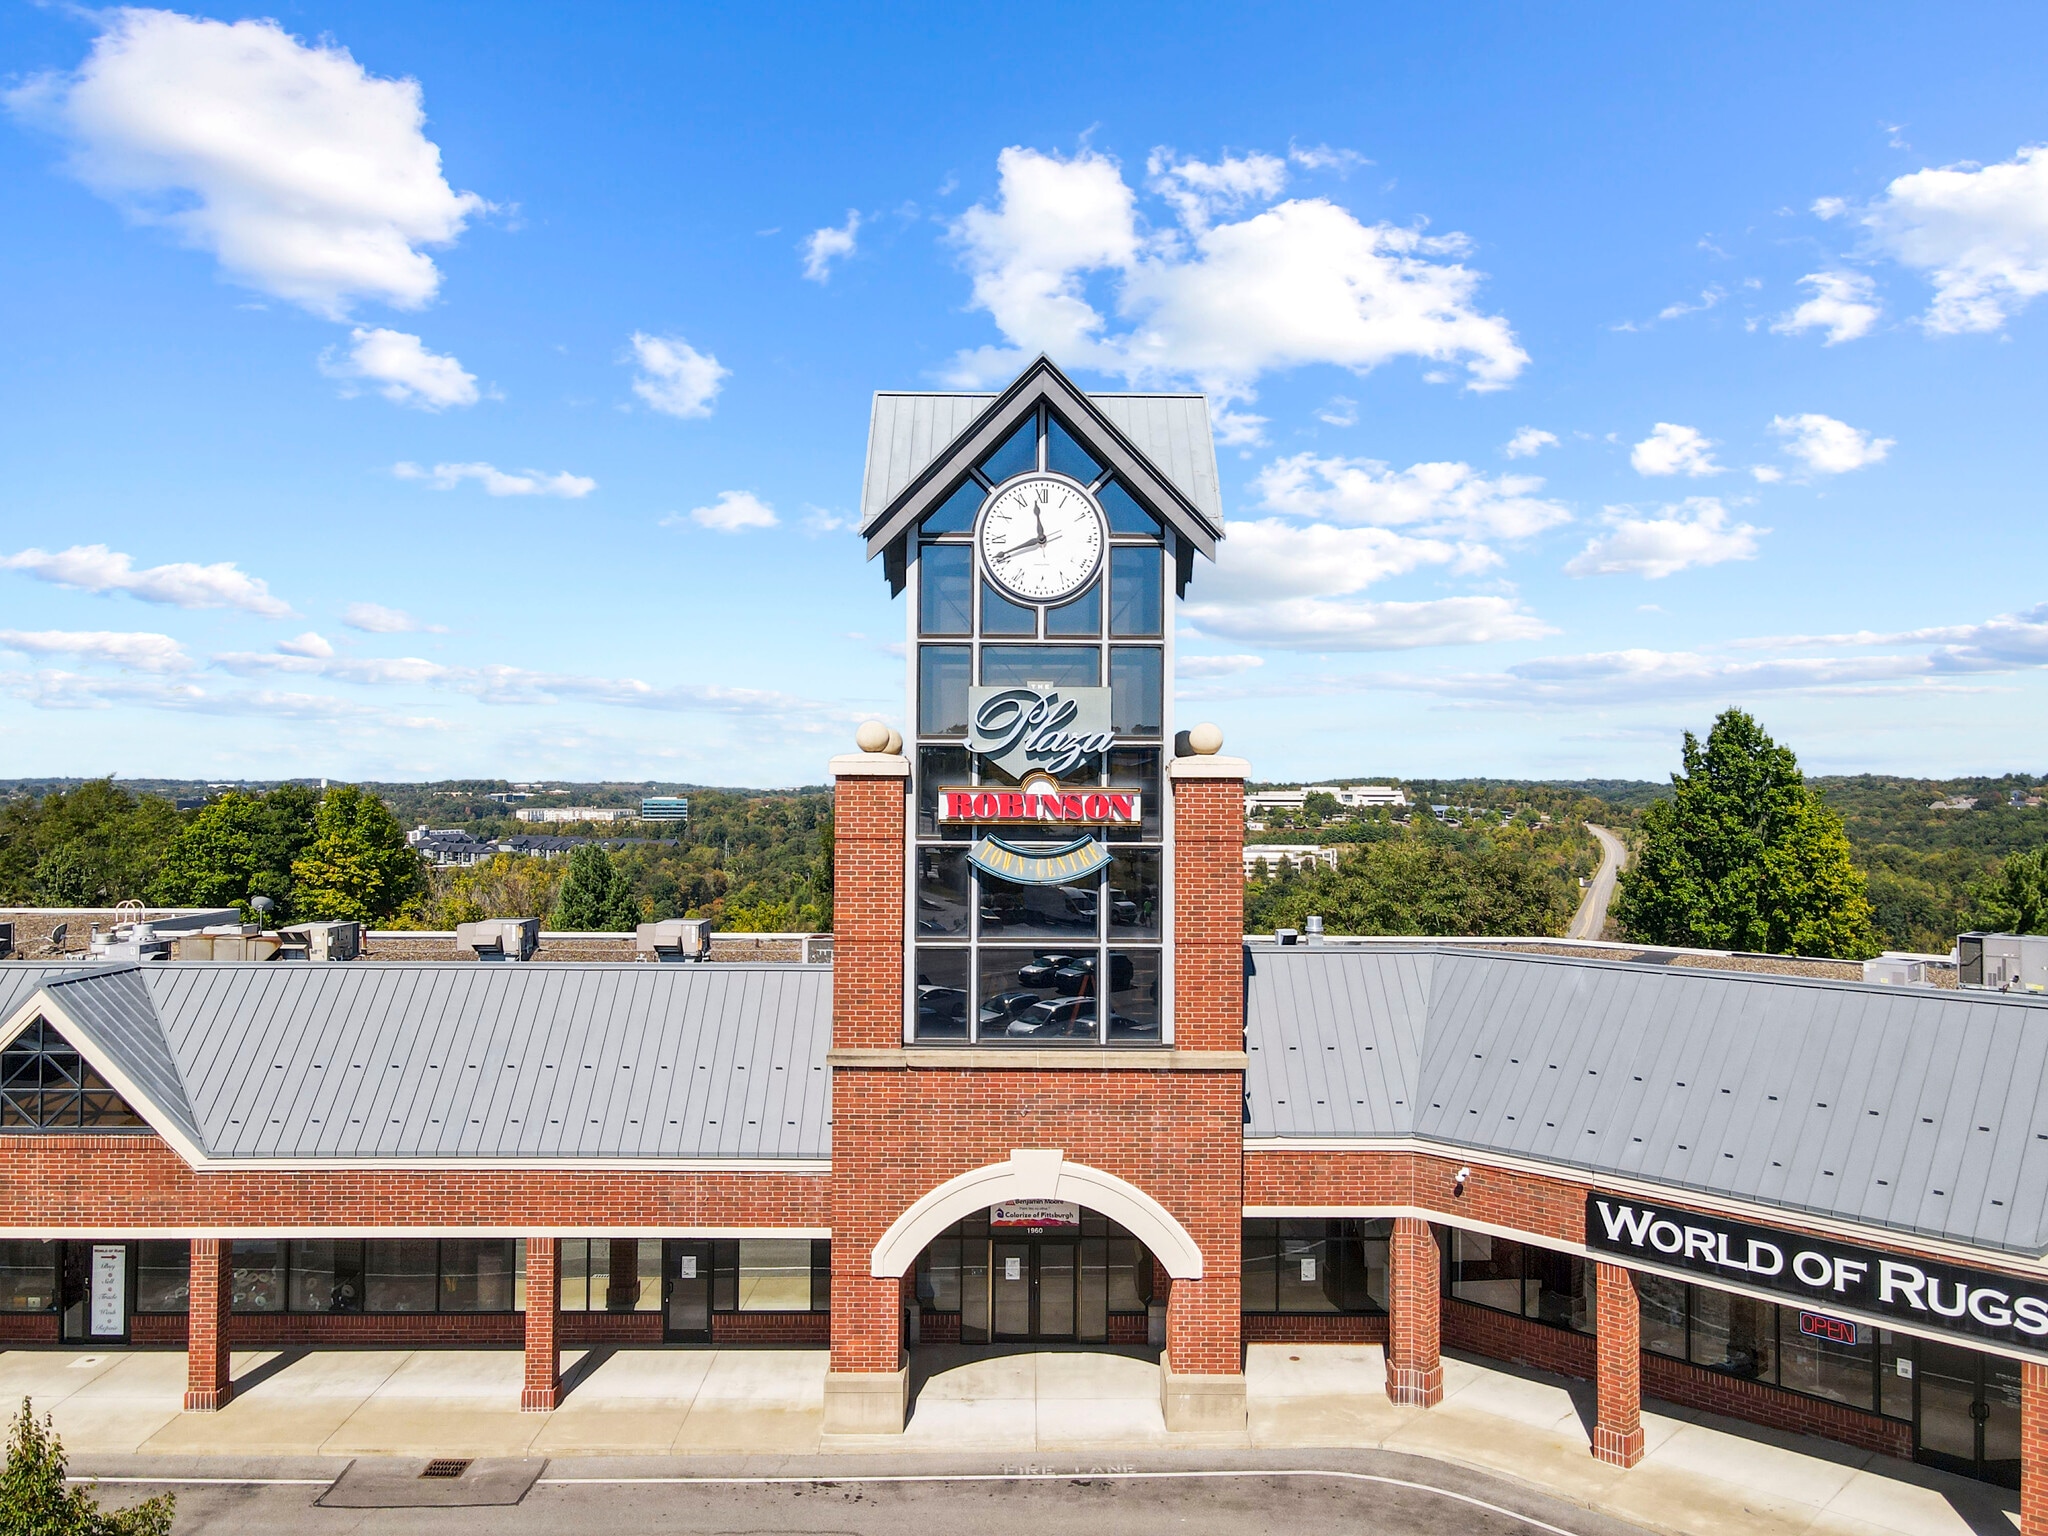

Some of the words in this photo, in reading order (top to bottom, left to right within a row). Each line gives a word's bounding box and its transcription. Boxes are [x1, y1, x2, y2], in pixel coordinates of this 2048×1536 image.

[1035, 488, 1049, 504] XII
[962, 688, 1117, 774] Plaza
[946, 792, 1135, 820] ROBINSON
[979, 842, 1025, 876] TOWN
[1035, 842, 1102, 879] CENTRE
[1040, 1211, 1074, 1219] Pittsburgh
[1595, 1200, 1784, 1277] WORLD
[1791, 1251, 1868, 1293] OF
[1878, 1259, 2048, 1336] RUGS
[1801, 1313, 1855, 1344] OPEN
[1003, 1464, 1056, 1476] FIRE
[1074, 1463, 1138, 1475] LANE
